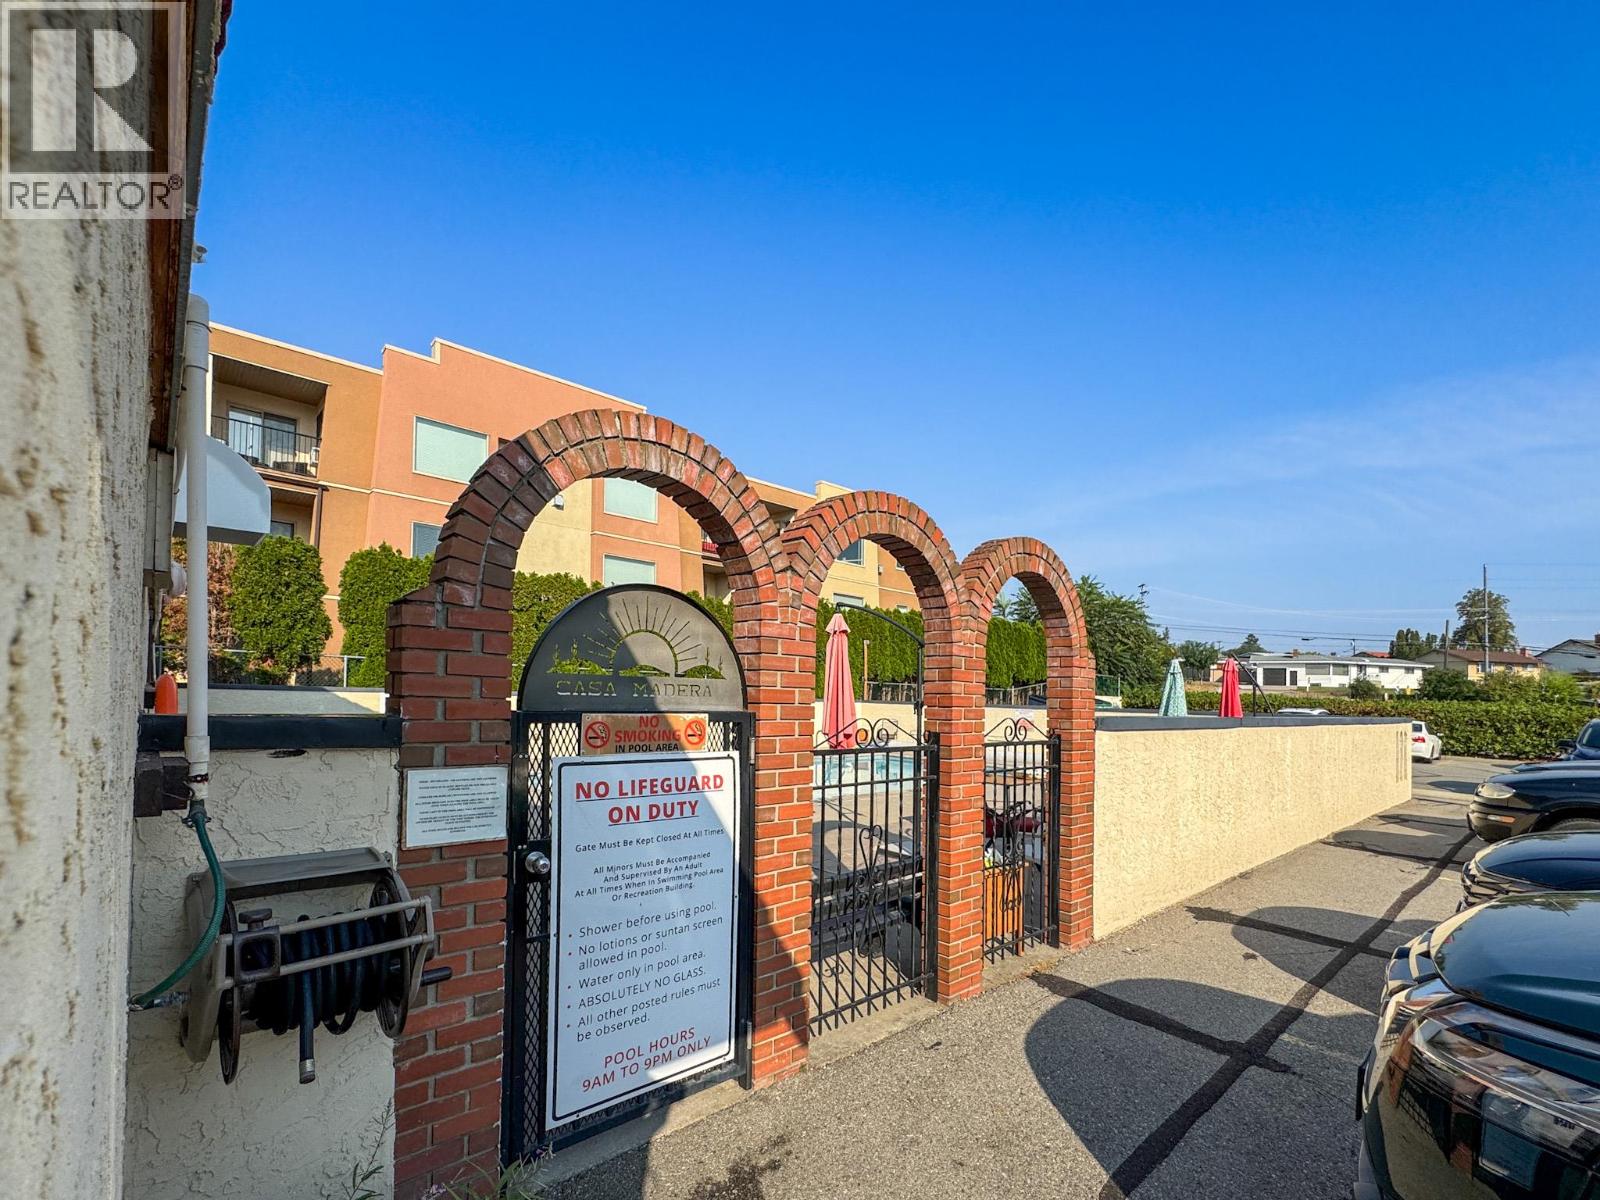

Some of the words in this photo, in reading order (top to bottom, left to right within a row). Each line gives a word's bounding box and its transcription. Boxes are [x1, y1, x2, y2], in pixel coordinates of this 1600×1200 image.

[556, 680, 617, 696] CASA
[632, 682, 713, 698] MADERA
[639, 716, 660, 728] NO
[614, 730, 681, 742] SMOKING
[615, 744, 625, 752] IN
[628, 744, 652, 752] POOL
[656, 744, 680, 752] AREA
[575, 781, 610, 799] NO
[618, 775, 724, 796] LIFEGUARD
[608, 806, 640, 824] ON
[649, 800, 699, 821] DUTY
[576, 844, 596, 852] Gate
[599, 841, 621, 849] Must
[636, 837, 654, 846] Kept
[656, 833, 682, 842] Closed
[594, 866, 604, 874] All
[606, 863, 634, 874] Minors
[636, 860, 654, 868] Must
[666, 852, 711, 864] Accompanied
[604, 874, 619, 883] And
[621, 868, 662, 880] Supervised
[685, 862, 702, 870] Adult
[586, 888, 597, 896] All
[600, 884, 622, 894] Times
[624, 880, 646, 890] When
[658, 873, 692, 884] Swimming
[694, 870, 708, 878] Pool
[624, 887, 664, 899] Recreation
[666, 882, 695, 892] Building.
[578, 922, 622, 938] Shower
[626, 914, 661, 928] before
[664, 908, 691, 920] using
[694, 900, 716, 916] pool.
[578, 944, 595, 956] No
[600, 936, 638, 952] lotions
[641, 933, 652, 942] or
[656, 924, 690, 939] suntan
[692, 916, 723, 930] screen
[578, 951, 624, 970] allowed
[627, 950, 637, 960] in
[641, 941, 667, 959] pool.
[578, 974, 614, 989] Water
[618, 966, 640, 980] only
[644, 963, 654, 973] in
[658, 955, 680, 972] pool
[682, 951, 706, 963] area.
[578, 981, 651, 1009] ABSOLUTELY
[654, 976, 670, 988] NO
[674, 966, 706, 982] GLASS.
[578, 1014, 592, 1028] All
[597, 1006, 628, 1022] other
[632, 993, 668, 1014] posted
[670, 986, 695, 1000] rules
[698, 978, 720, 992] must
[577, 1032, 592, 1042] be
[596, 1012, 650, 1037] observed.
[604, 1046, 644, 1068] POOL
[650, 1027, 695, 1053] HOURS
[582, 1070, 615, 1093] 9AM
[620, 1062, 638, 1078] TO
[644, 1050, 672, 1070] 9PM
[677, 1036, 711, 1057] ONLY
